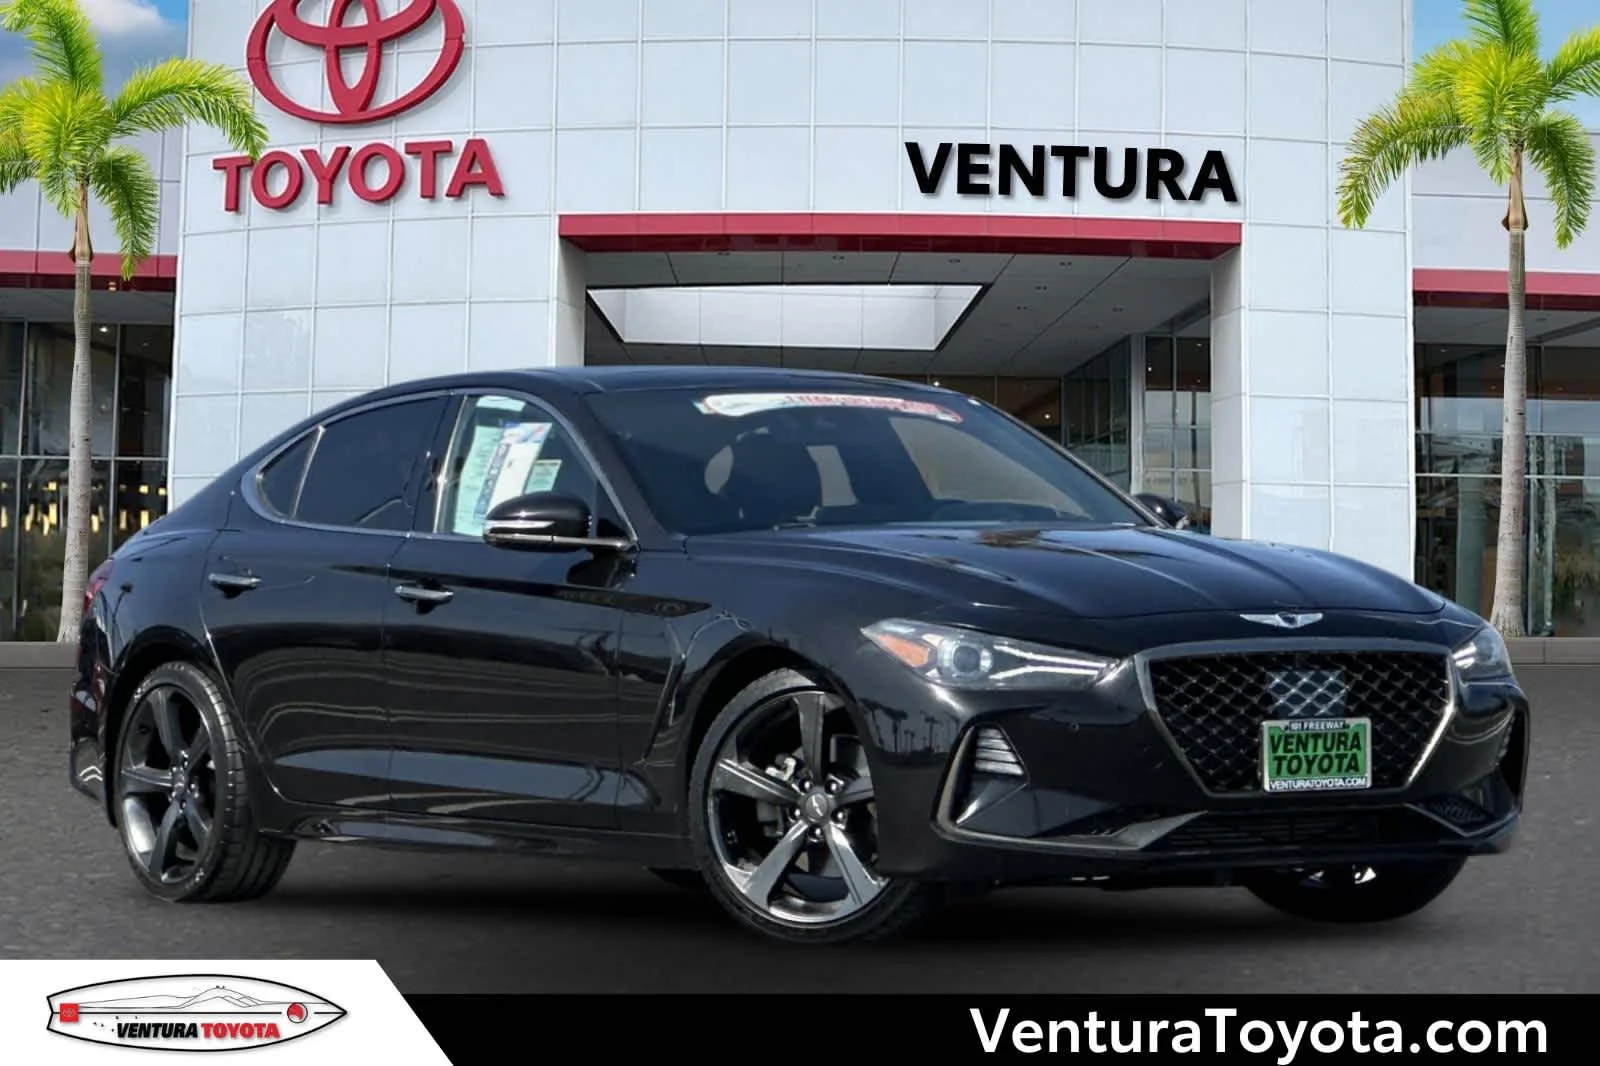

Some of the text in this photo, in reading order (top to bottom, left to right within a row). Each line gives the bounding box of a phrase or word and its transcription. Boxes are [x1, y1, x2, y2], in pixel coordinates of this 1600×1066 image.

[213, 138, 505, 212] TOYOTA
[904, 142, 1238, 202] VENTURA
[1303, 720, 1344, 731] FREEWAY
[1269, 731, 1361, 754] VENTURA
[1273, 752, 1360, 776] TOYOTA
[1270, 777, 1366, 790] VENTURATOYOTA.COM
